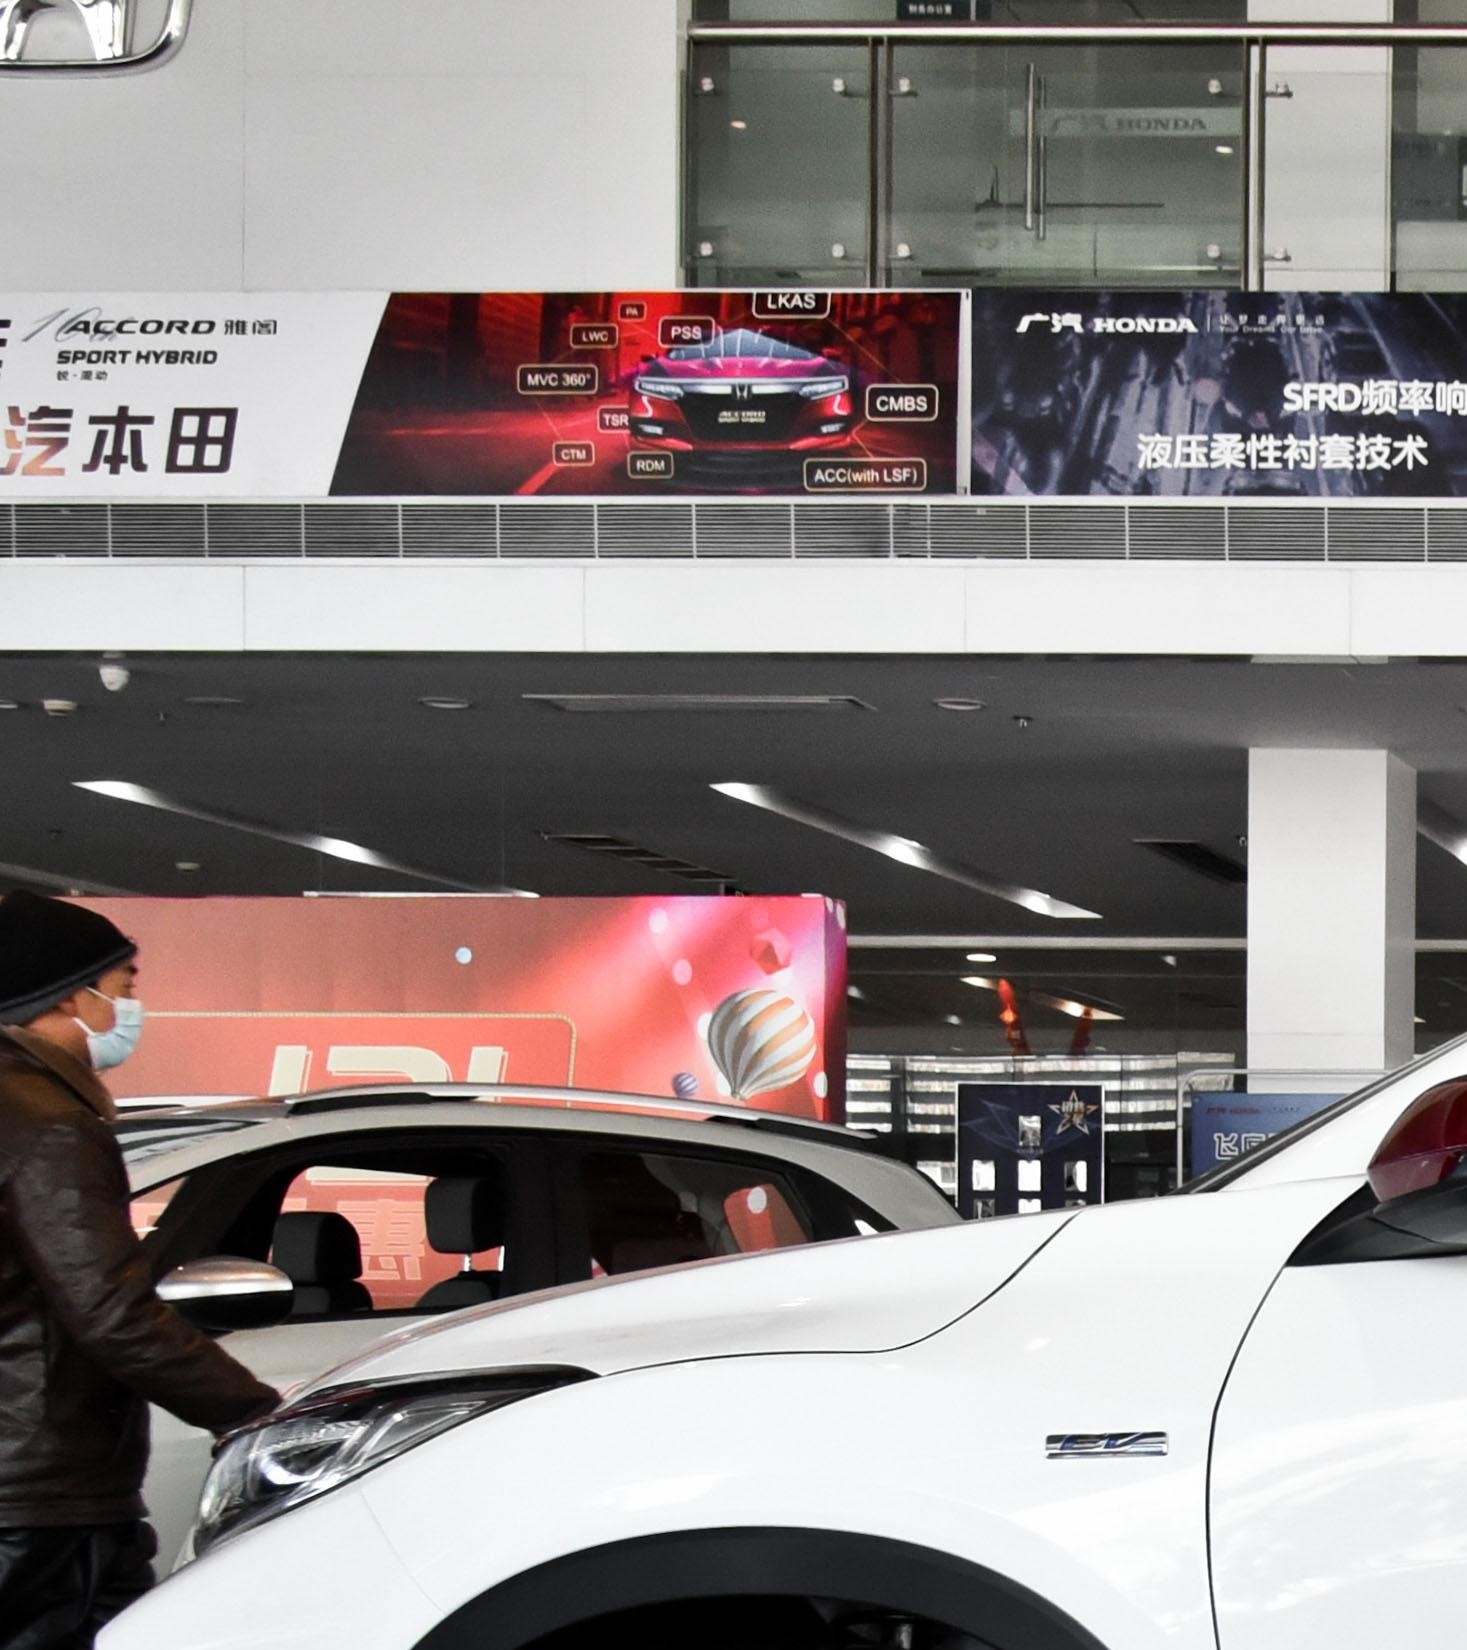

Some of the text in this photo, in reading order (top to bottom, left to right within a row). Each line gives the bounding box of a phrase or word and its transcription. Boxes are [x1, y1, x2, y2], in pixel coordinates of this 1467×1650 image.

[767, 293, 816, 310] LKAS
[63, 319, 216, 335] ACCORD
[224, 319, 278, 335] 雅阁
[1016, 313, 1083, 333] 广汽
[1093, 316, 1199, 333] HONDA
[582, 331, 609, 342] LWC
[670, 325, 702, 340] PSS
[56, 350, 218, 365] SPORT HYBRID
[527, 372, 592, 387] MVC 360°
[876, 396, 928, 412] CMBS
[603, 413, 629, 427] TSR
[561, 448, 587, 461] CTM
[1137, 433, 1429, 471] 液压柔性衬套技术
[636, 458, 665, 472] RDM
[814, 468, 918, 485] ACC(with LSF)
